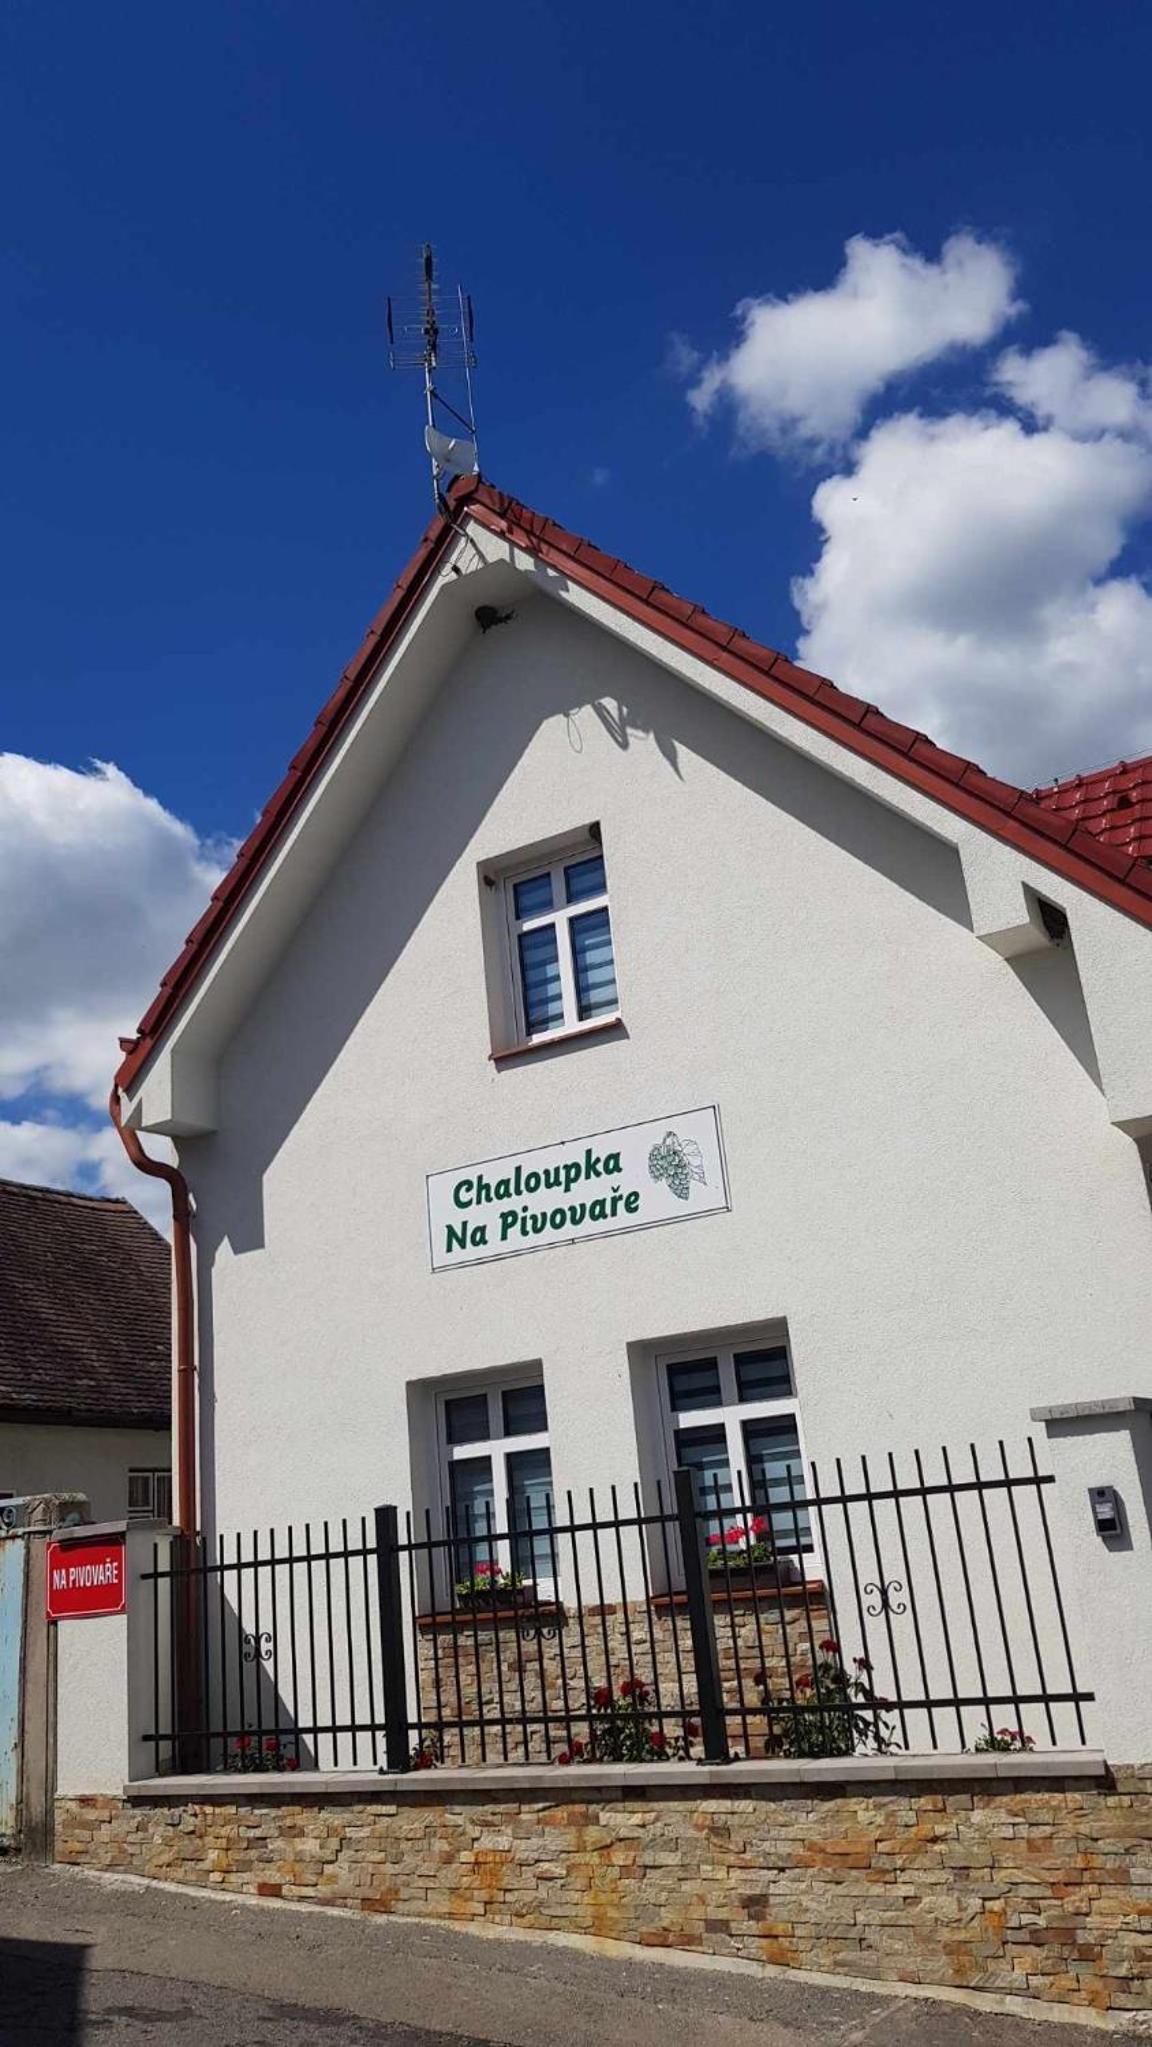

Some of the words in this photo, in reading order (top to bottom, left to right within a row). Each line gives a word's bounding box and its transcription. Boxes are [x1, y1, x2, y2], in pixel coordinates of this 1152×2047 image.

[453, 1148, 622, 1209] Chaloupka
[446, 1221, 488, 1252] Na
[500, 1185, 640, 1241] Pivovaře
[53, 1568, 67, 1590] NA
[69, 1557, 118, 1589] PIVOVAŘE
